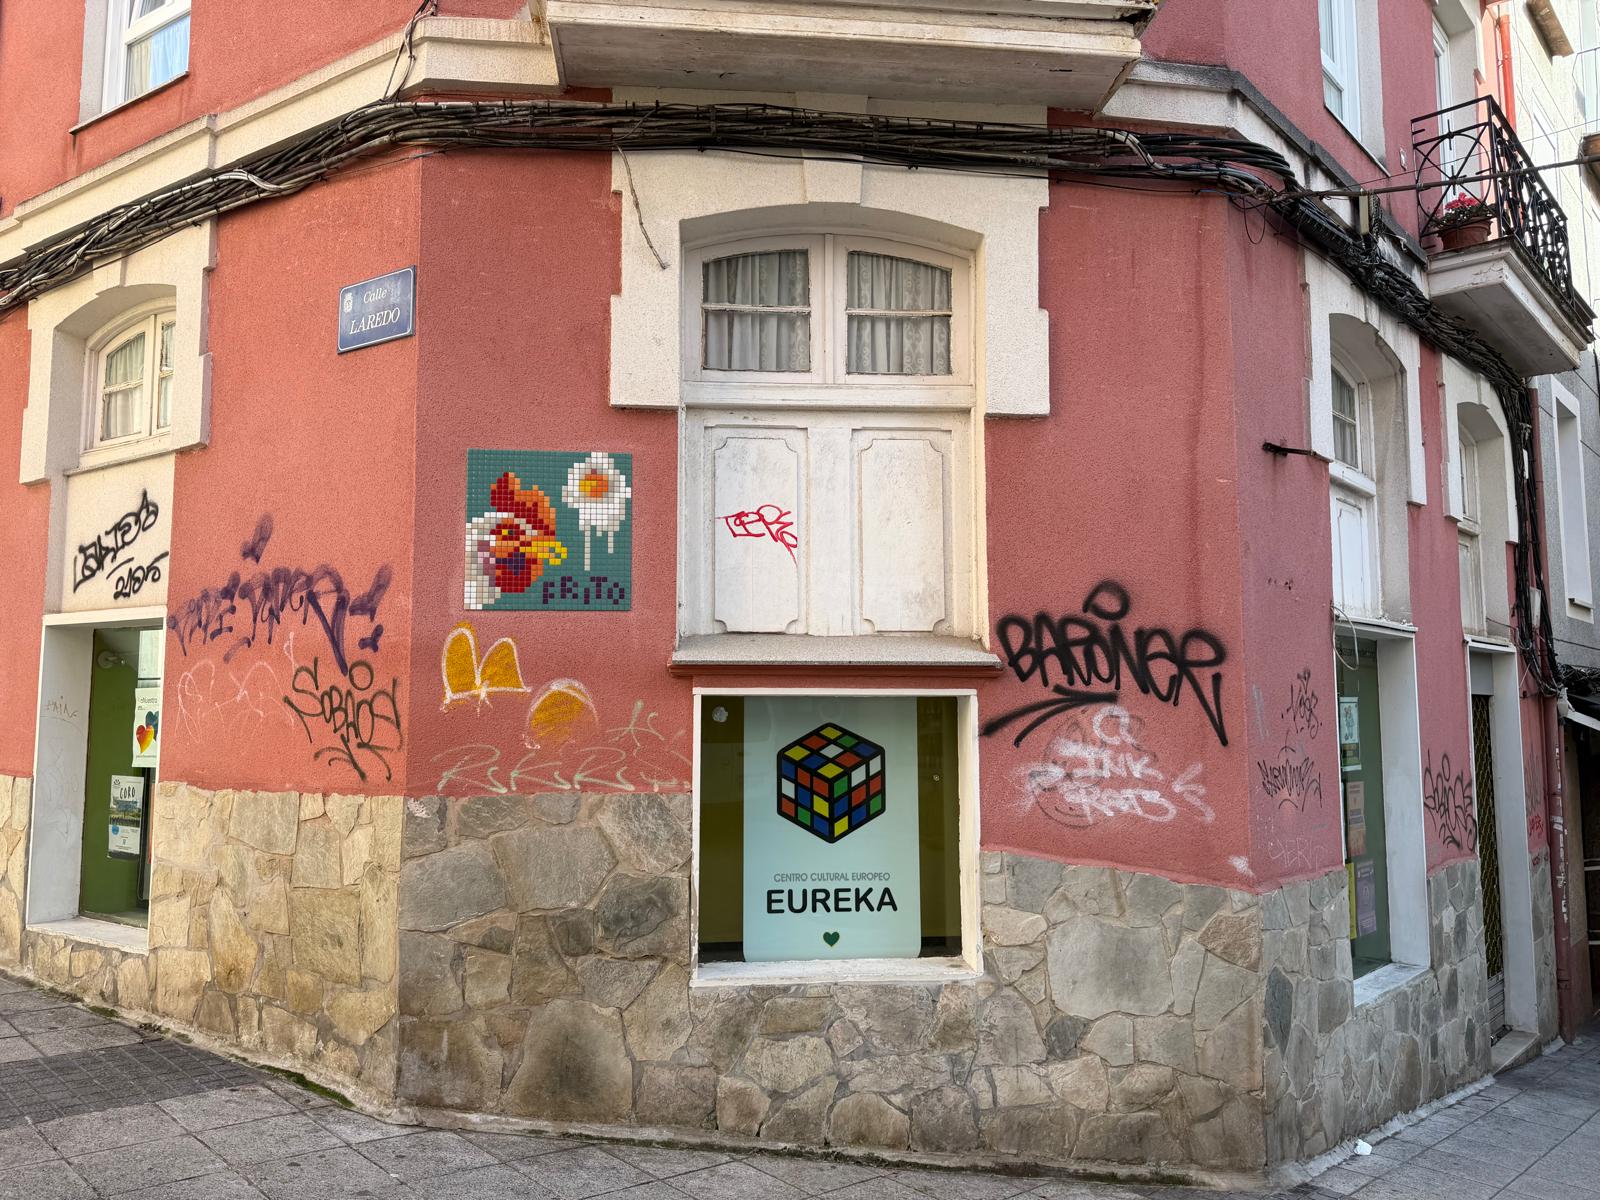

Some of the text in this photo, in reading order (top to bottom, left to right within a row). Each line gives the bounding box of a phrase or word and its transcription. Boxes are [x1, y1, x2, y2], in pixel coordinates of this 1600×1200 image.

[364, 287, 388, 304] Calle
[349, 307, 400, 335] LAREDO
[543, 576, 625, 605] FRITO
[773, 872, 891, 883] CENTRO CULTURAL EUROPEO
[766, 887, 898, 914] EUREKA
